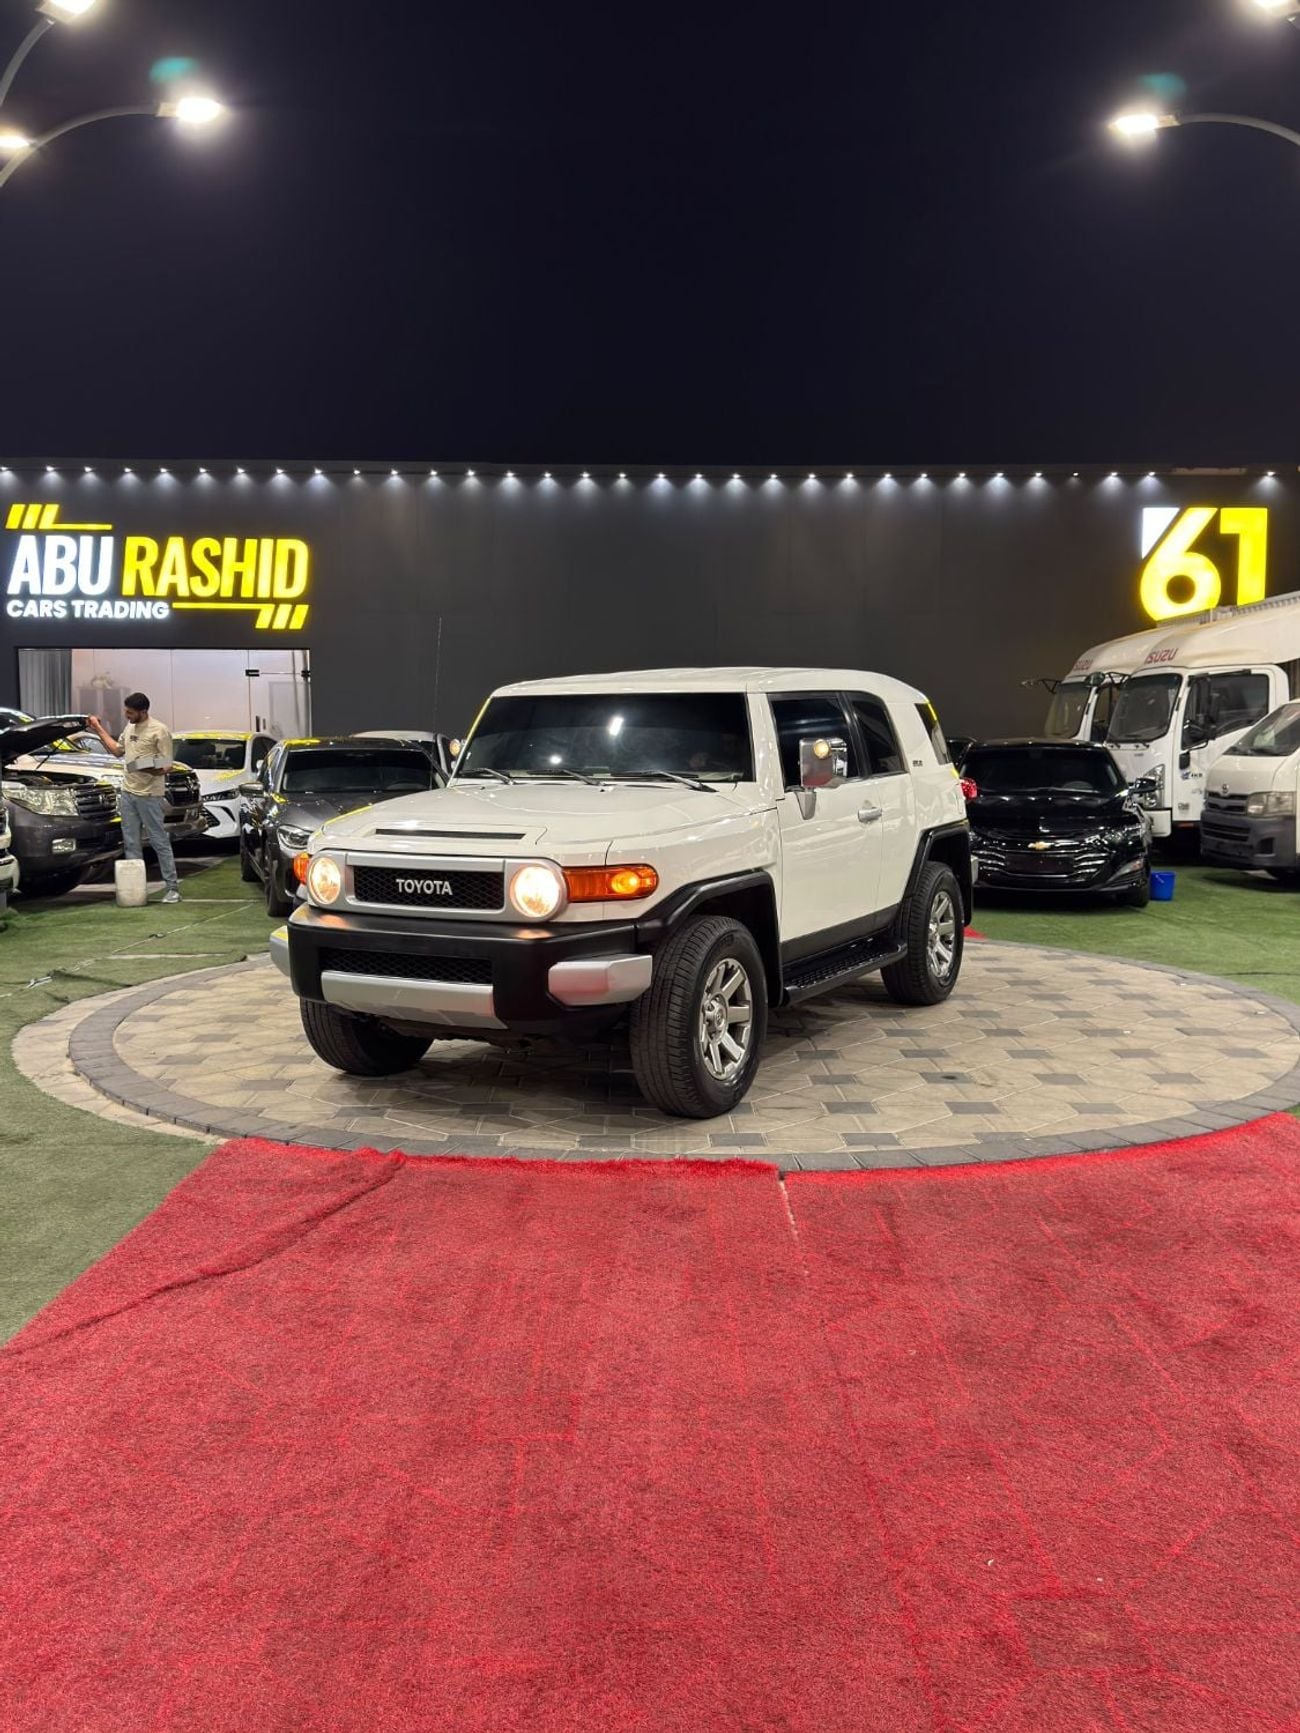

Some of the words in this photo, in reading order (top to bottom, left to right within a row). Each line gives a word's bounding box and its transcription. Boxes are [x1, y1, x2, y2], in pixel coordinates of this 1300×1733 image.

[7, 535, 114, 595] ABU
[122, 536, 309, 598] RASHID
[1140, 508, 1268, 621] 61
[7, 600, 67, 618] CARS
[71, 600, 169, 619] TRADING
[1144, 648, 1179, 665] ISUZU
[396, 879, 453, 896] TOYOTA
